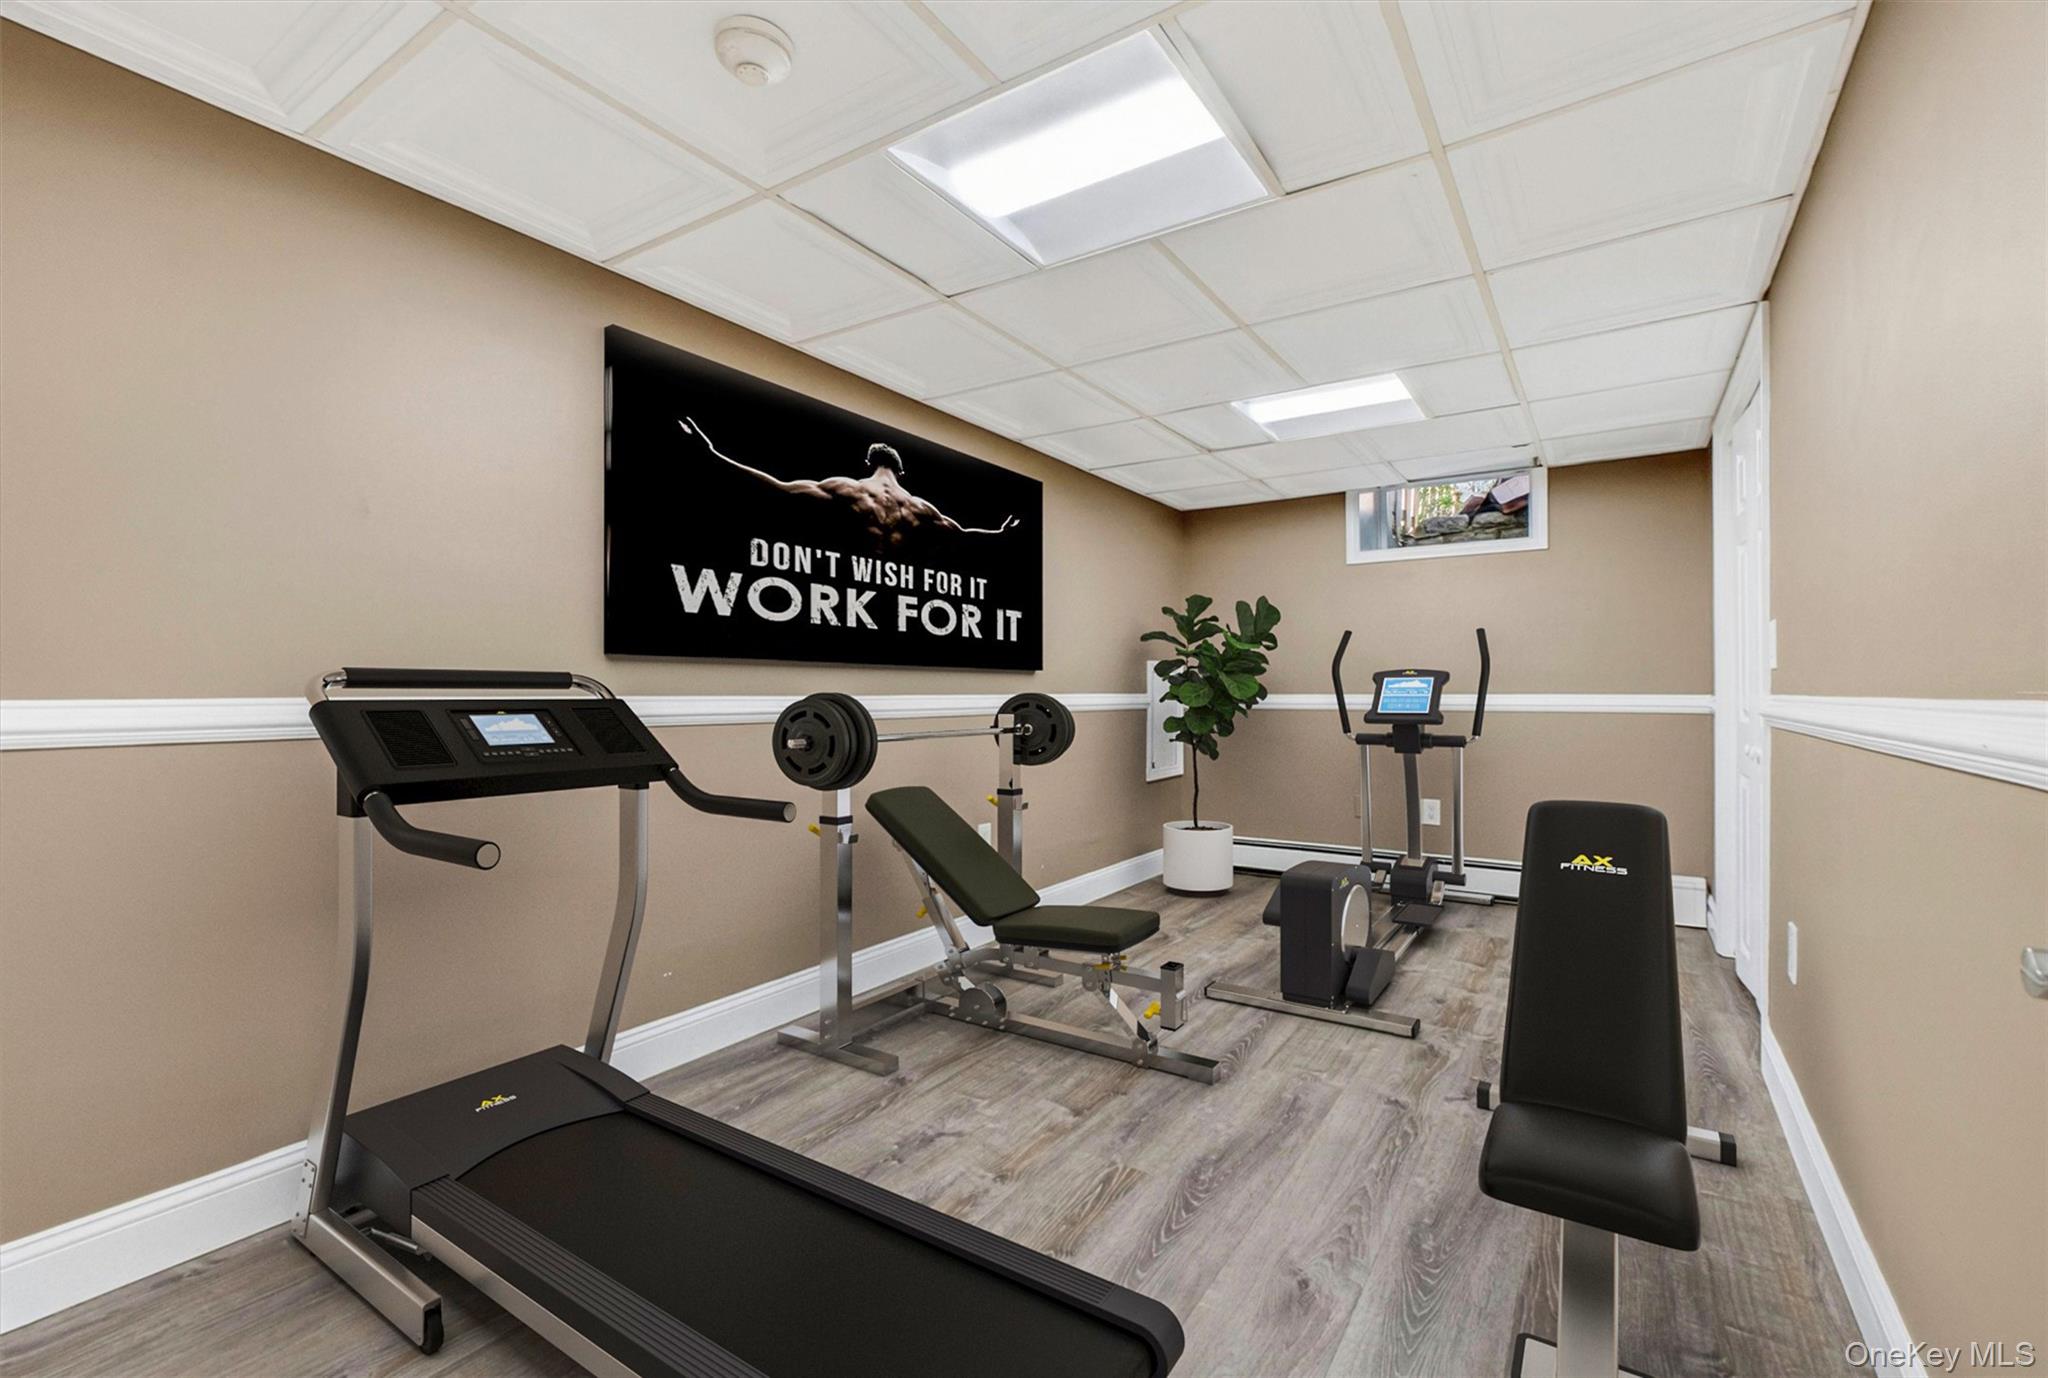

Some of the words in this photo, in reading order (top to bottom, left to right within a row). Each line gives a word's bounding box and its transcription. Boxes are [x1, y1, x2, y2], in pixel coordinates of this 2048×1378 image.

[750, 537, 841, 578] DON'T
[851, 555, 914, 590] WISH
[923, 568, 962, 597] FOR
[969, 576, 988, 600] IT
[670, 563, 879, 630] WORK
[898, 594, 983, 639] FOR
[996, 608, 1023, 642] IT
[1571, 854, 1613, 868] AX
[1560, 862, 1628, 875] FITNESS
[481, 1094, 508, 1107] AX
